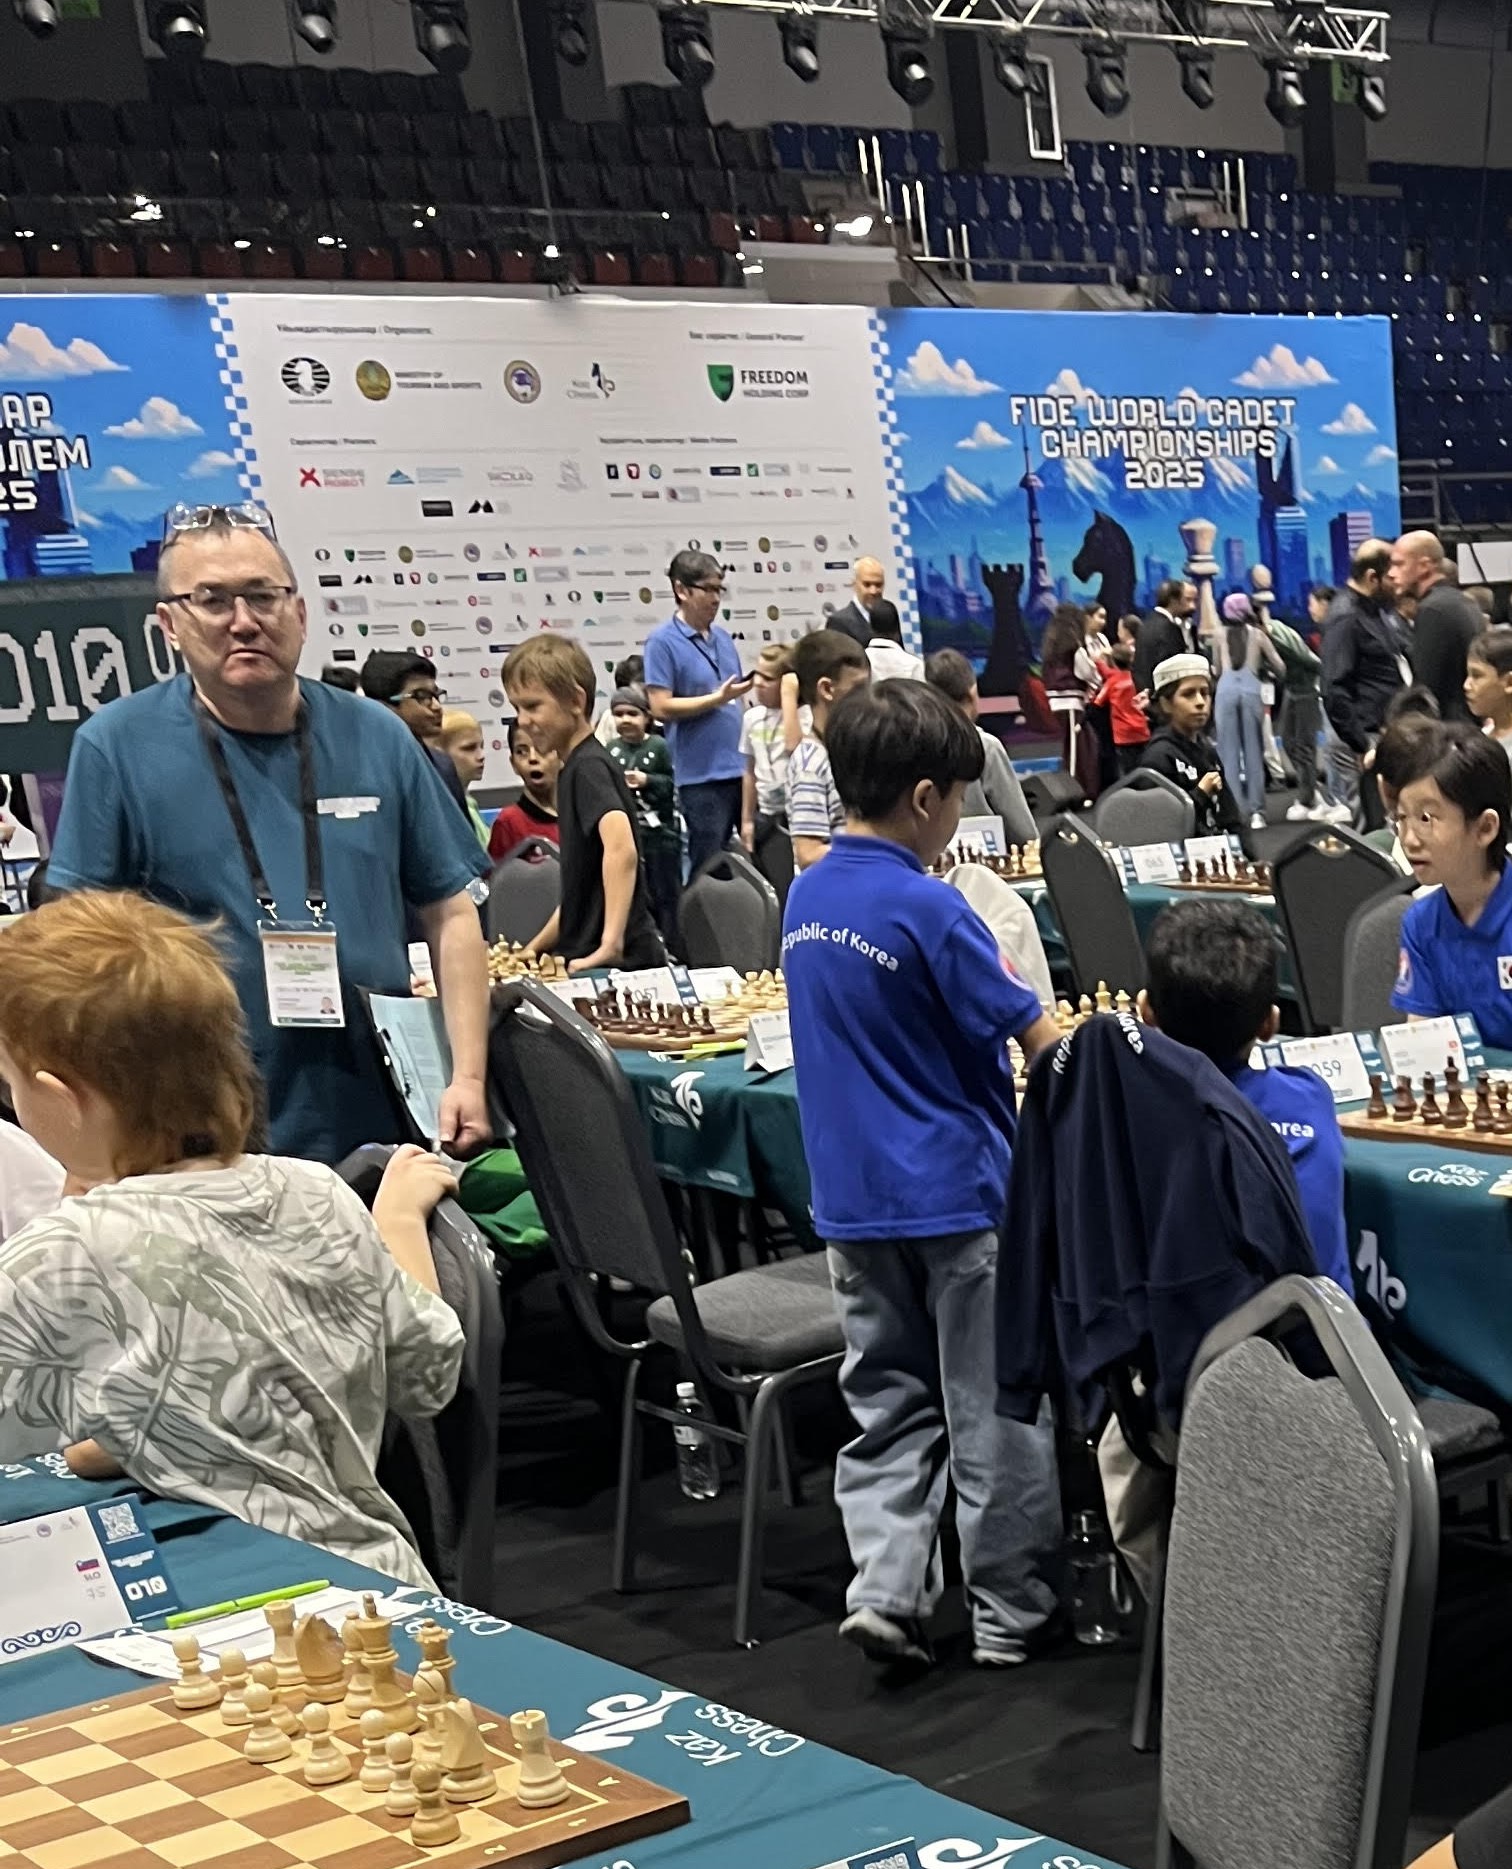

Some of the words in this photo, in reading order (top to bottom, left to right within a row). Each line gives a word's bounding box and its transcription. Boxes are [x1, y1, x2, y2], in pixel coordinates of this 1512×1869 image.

[740, 370, 809, 385] FREEDOM
[0, 395, 52, 428] АР
[1010, 397, 1077, 426] FIDE
[1087, 397, 1196, 427] WORLD
[1206, 399, 1296, 427] CADET
[0, 437, 90, 473] ЛЕМ
[1040, 430, 1277, 458] CHAMPIONSHIPS
[1125, 461, 1205, 489] 2025
[781, 922, 829, 951] epublic
[831, 928, 849, 944] of
[850, 933, 899, 973] Korea
[1271, 1121, 1315, 1139] orea
[694, 1702, 807, 1760] Chess
[664, 1728, 742, 1767] Kaz
